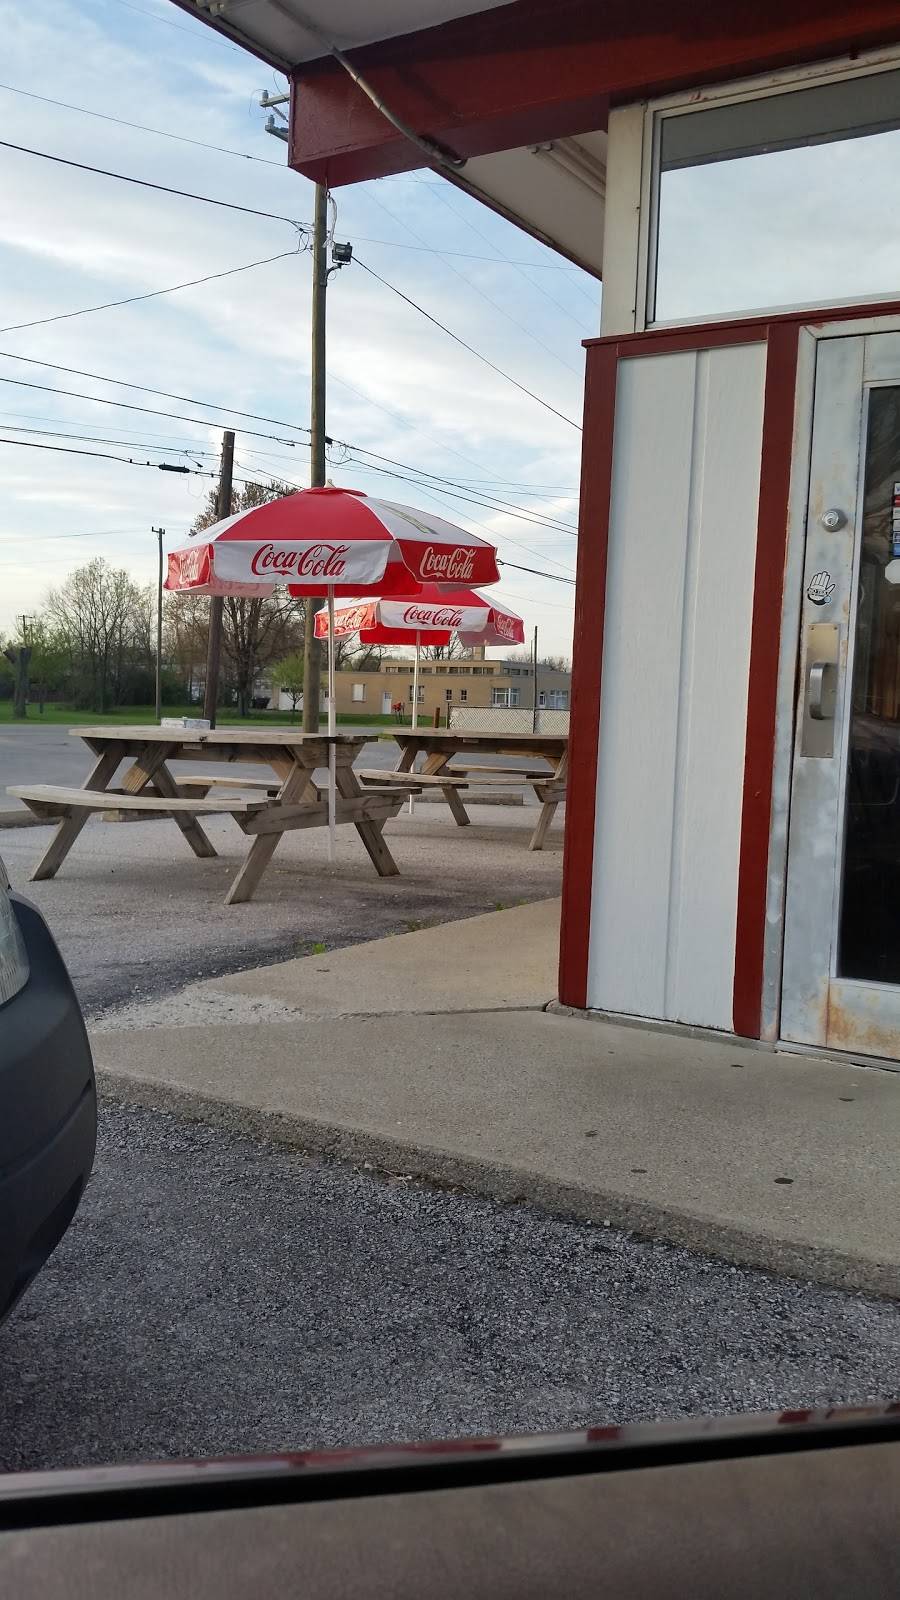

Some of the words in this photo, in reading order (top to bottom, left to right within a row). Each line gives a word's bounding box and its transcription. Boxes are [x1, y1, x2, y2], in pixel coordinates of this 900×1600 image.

[251, 543, 351, 577] Coca-Cola
[420, 546, 476, 579] Coca-Cola
[403, 605, 465, 627] Coca-Cola
